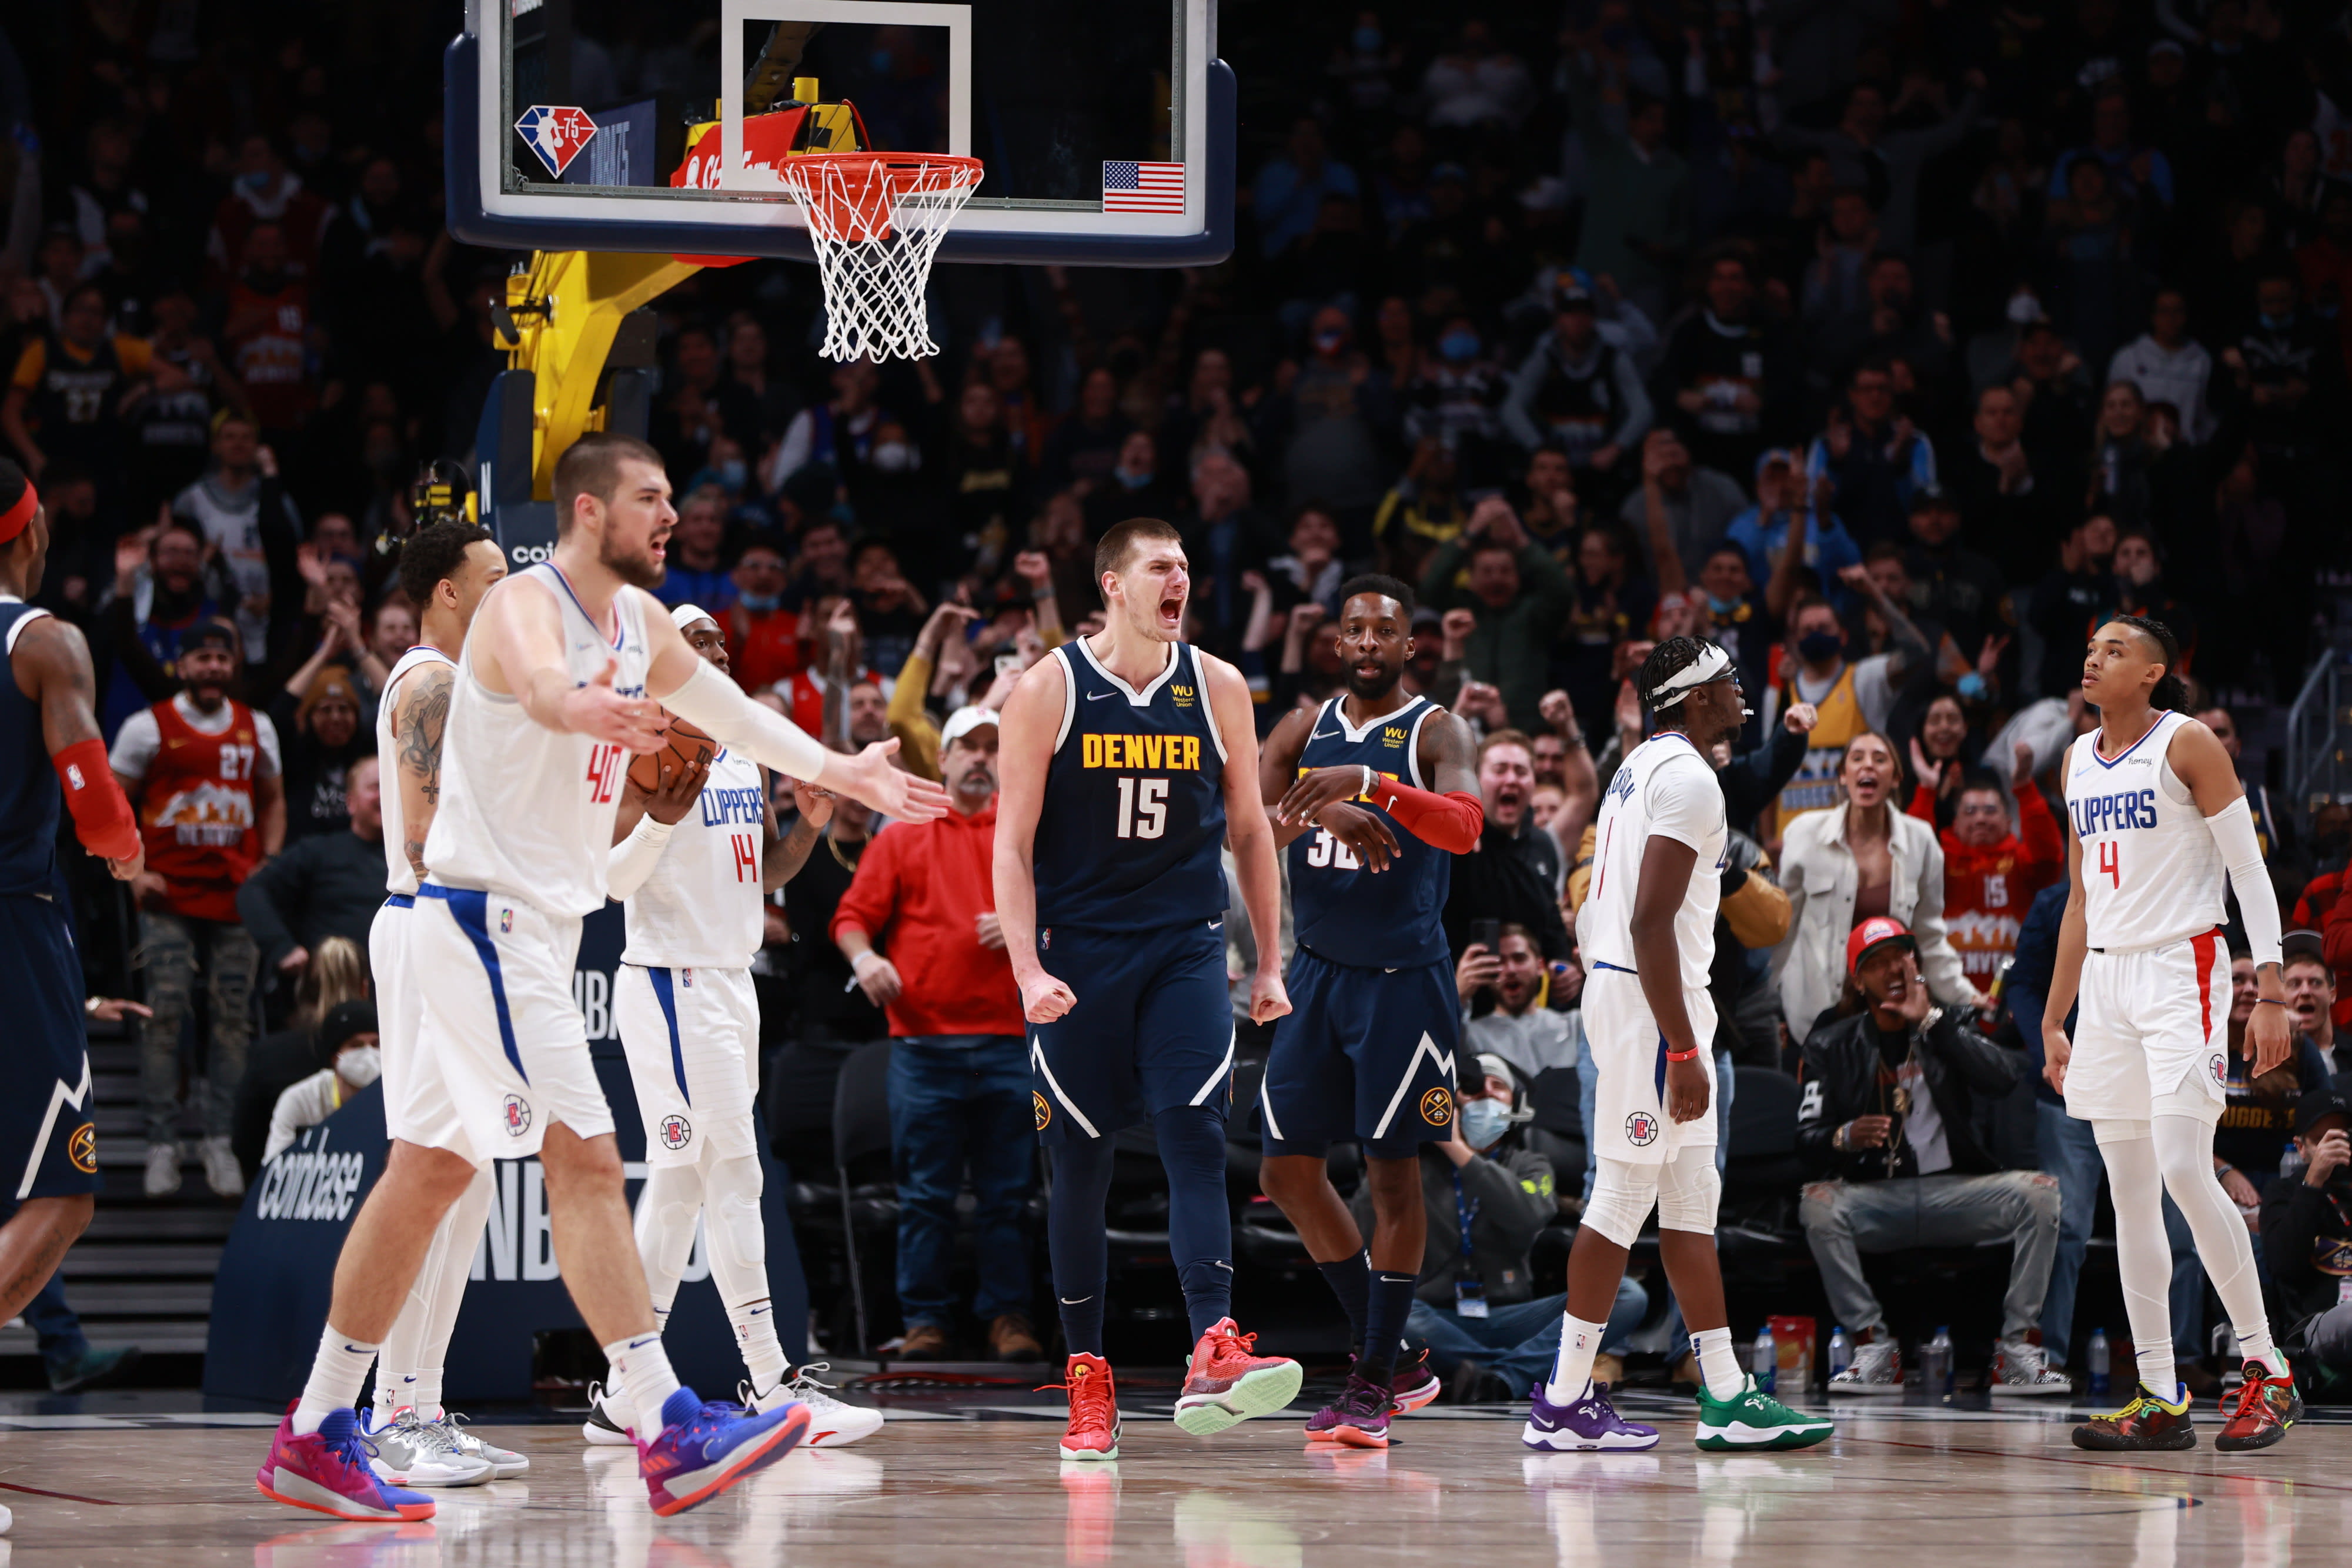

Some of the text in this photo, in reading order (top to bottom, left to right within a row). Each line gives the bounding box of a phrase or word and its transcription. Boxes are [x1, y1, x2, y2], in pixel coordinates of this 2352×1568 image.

[563, 117, 580, 139] 75
[1170, 684, 1194, 697] WU
[1082, 733, 1201, 771] DENVER
[1385, 726, 1408, 740] WU
[218, 743, 256, 781] 27
[586, 743, 622, 804] 40
[2128, 756, 2153, 767] honey
[700, 785, 764, 827] CLIPPERS
[1117, 776, 1170, 840] 15
[2069, 788, 2158, 838] CLIPPERS
[730, 833, 757, 883] 14
[2099, 841, 2120, 890] 4
[1983, 874, 2010, 909] 15
[257, 1126, 365, 1222] coinbase
